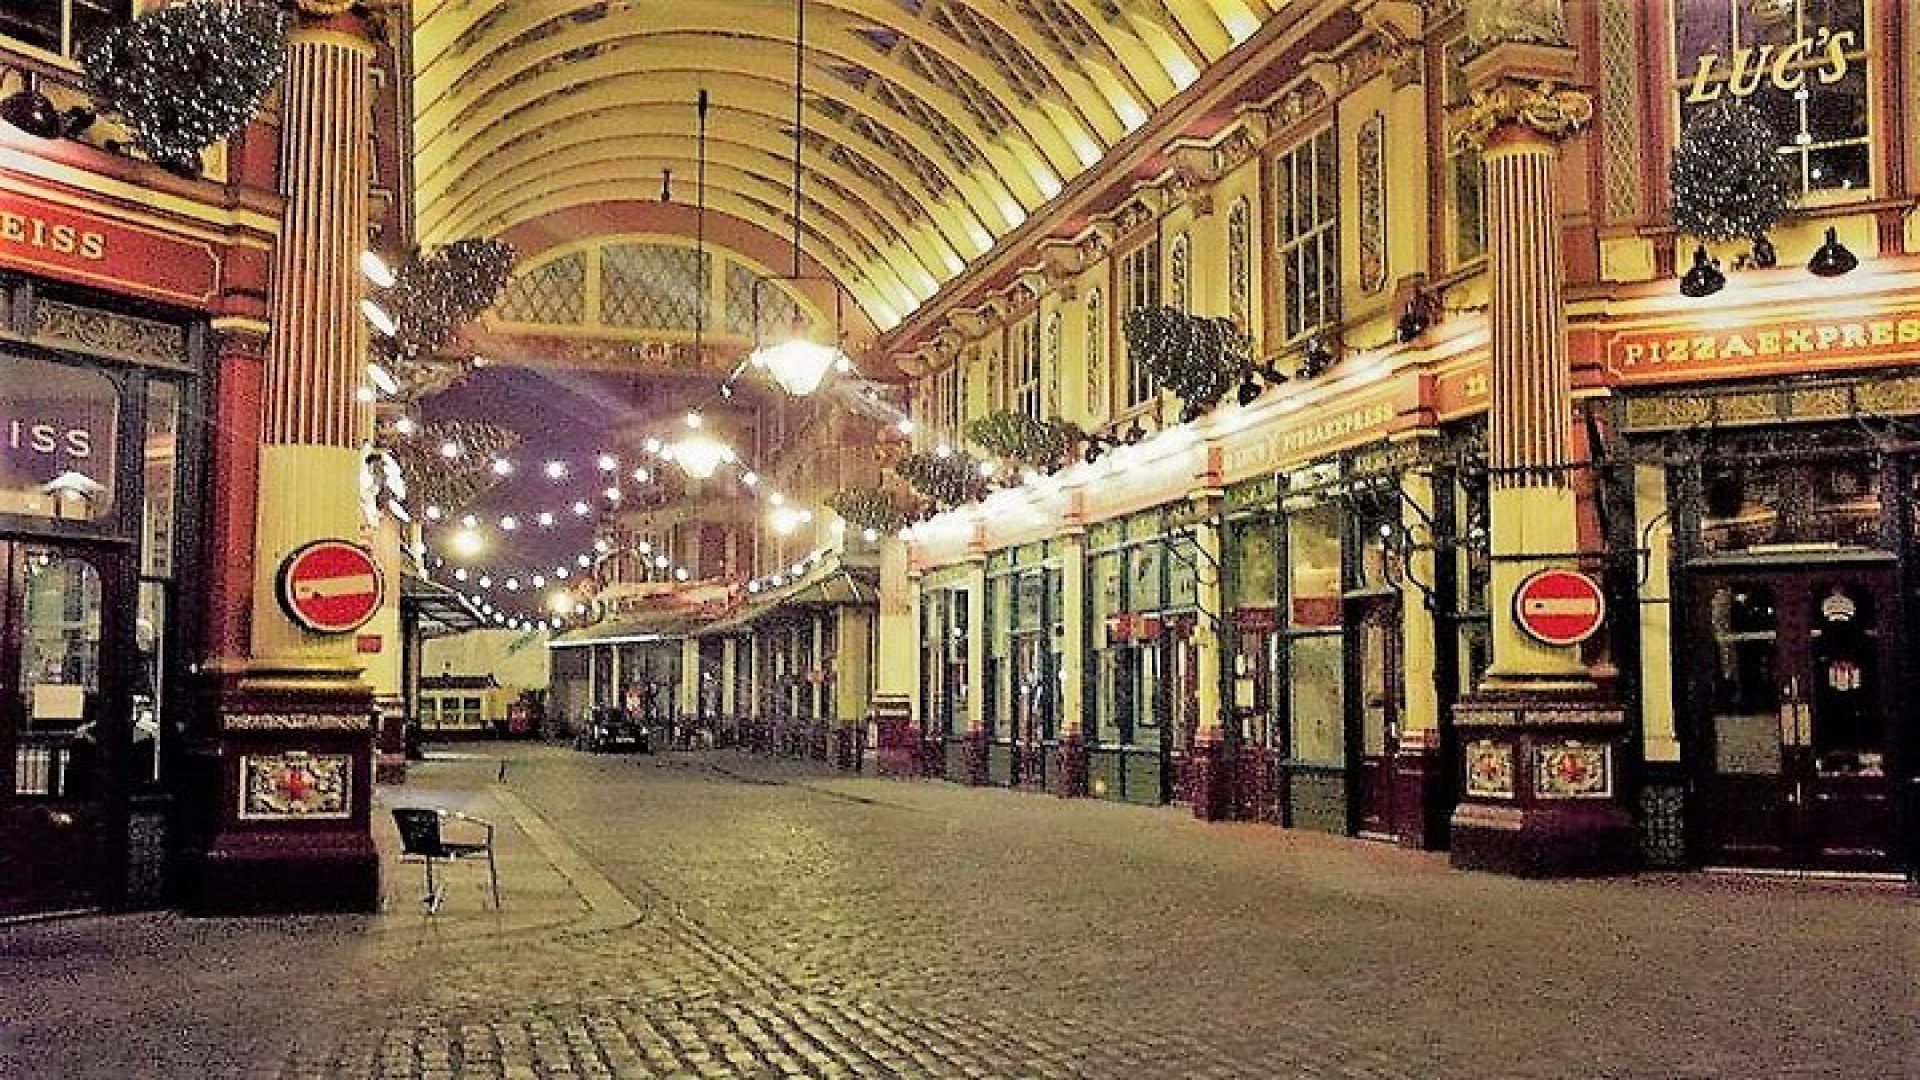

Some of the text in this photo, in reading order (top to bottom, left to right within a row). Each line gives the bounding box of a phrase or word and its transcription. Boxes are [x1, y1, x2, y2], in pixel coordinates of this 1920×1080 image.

[1686, 27, 1854, 103] LUC'S
[0, 213, 105, 260] EISS
[1624, 319, 1920, 365] PIZZAEXPRES
[10, 420, 90, 457] ISS
